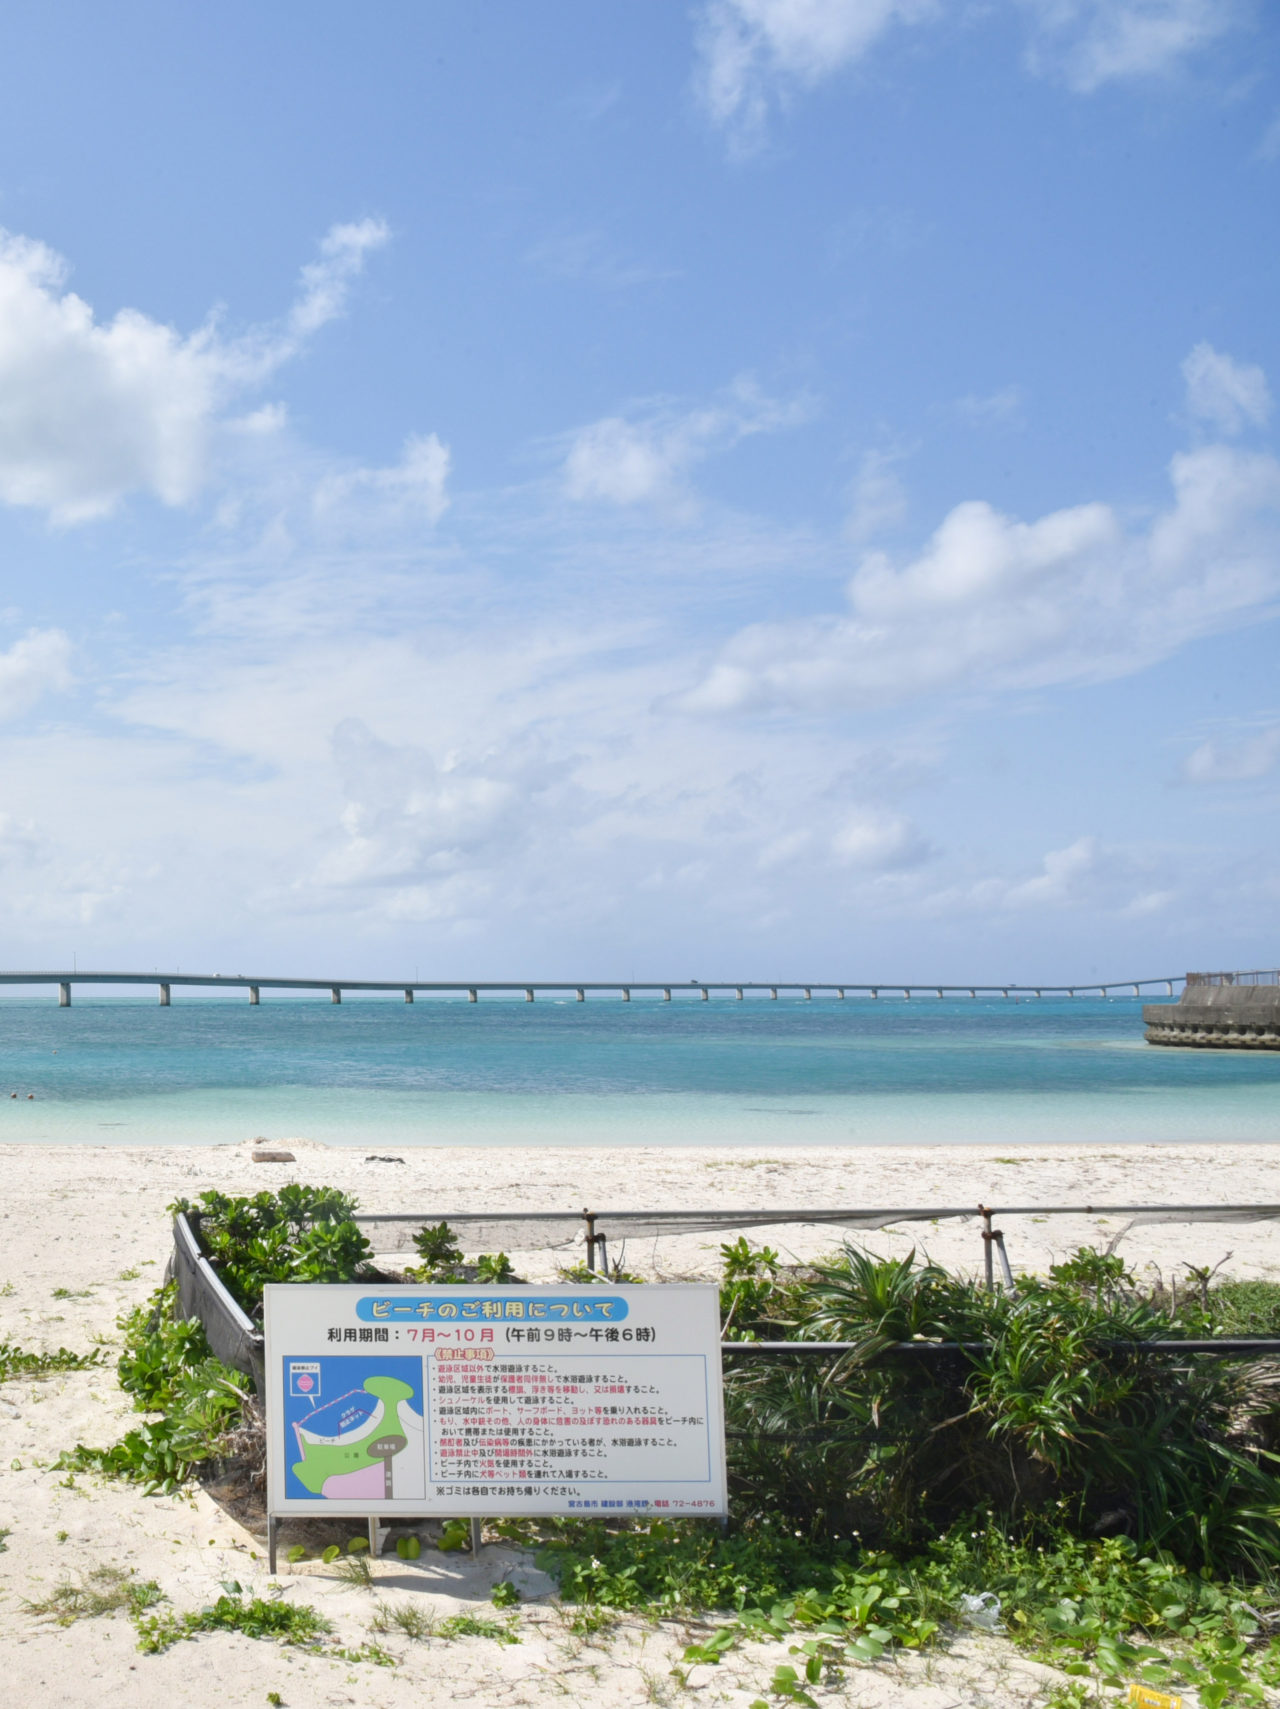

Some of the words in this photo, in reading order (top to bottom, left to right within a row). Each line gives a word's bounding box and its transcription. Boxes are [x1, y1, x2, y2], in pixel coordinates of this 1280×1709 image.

[371, 1300, 614, 1319] ビーチのご利用について
